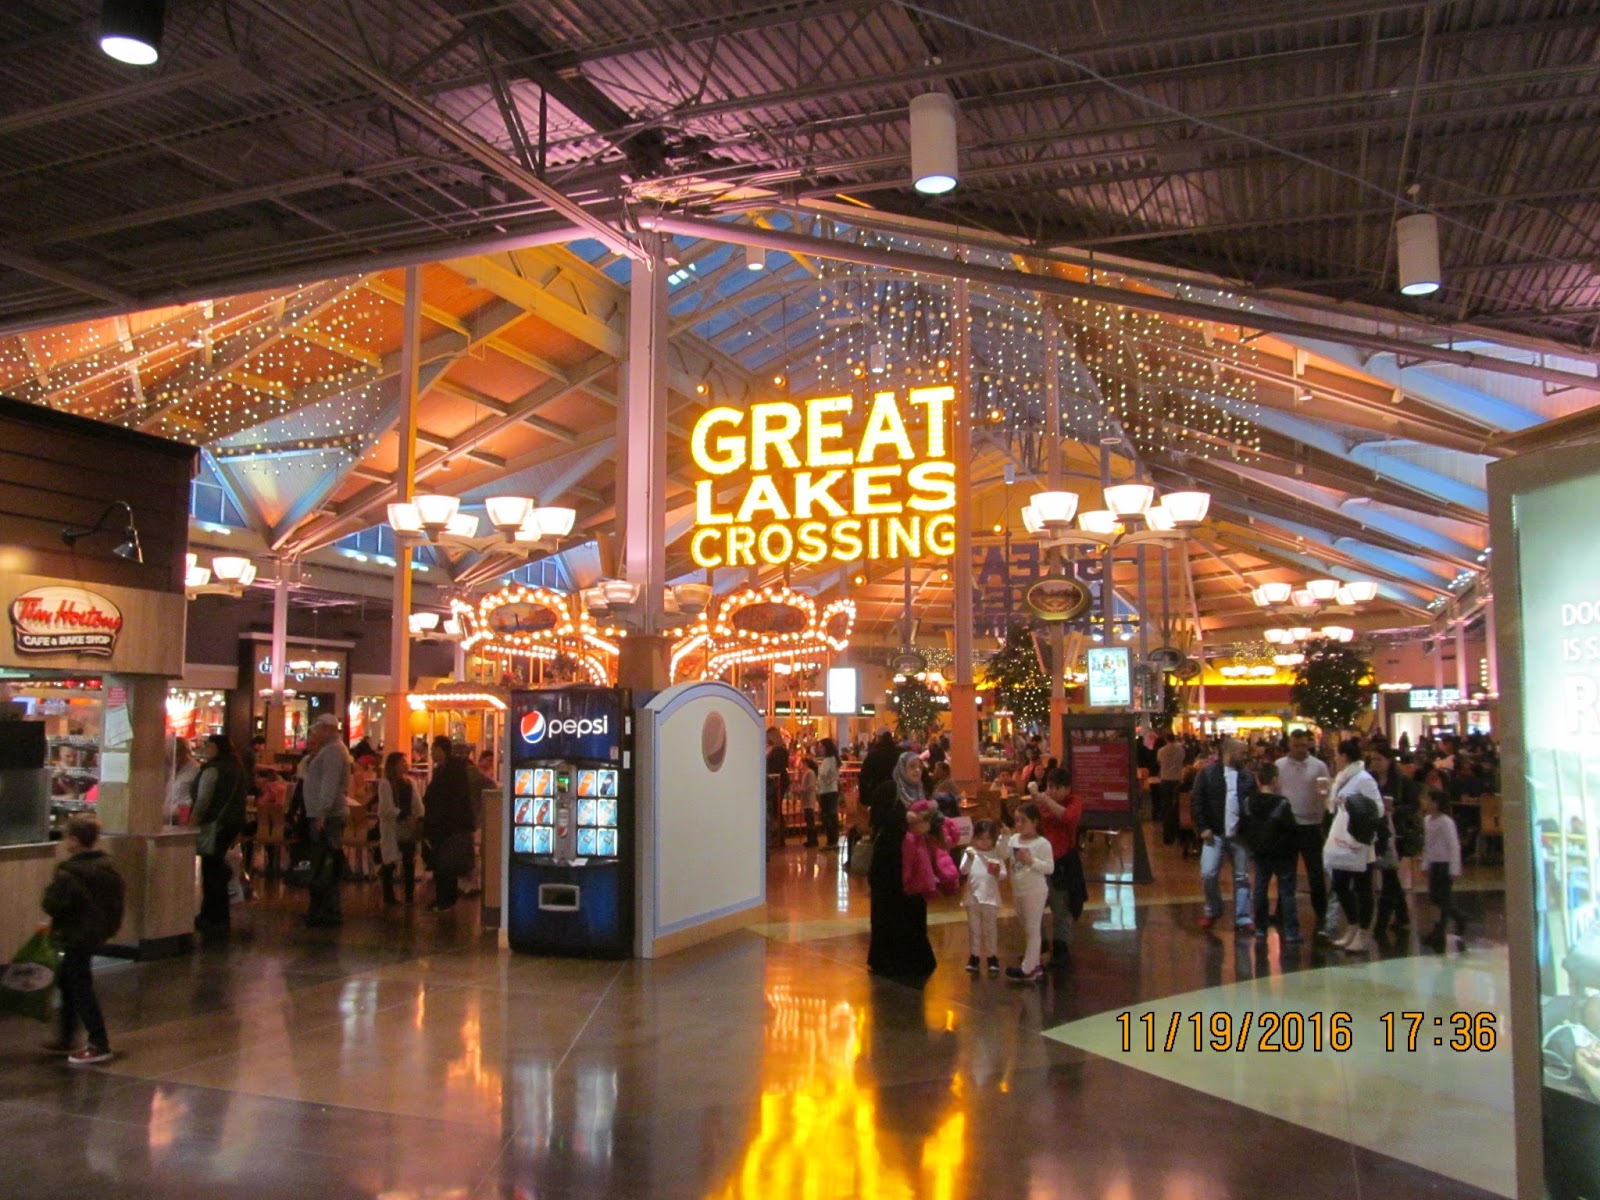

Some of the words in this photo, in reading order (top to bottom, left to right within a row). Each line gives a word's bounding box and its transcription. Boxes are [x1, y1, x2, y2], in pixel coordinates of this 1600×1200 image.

[691, 386, 955, 474] GREAT
[691, 461, 956, 526] LAKES
[691, 514, 956, 567] CROSSING
[18, 597, 52, 624] Tim
[55, 600, 122, 629] Hortons
[23, 636, 50, 647] CAFE
[59, 636, 84, 645] BAKE
[86, 635, 110, 644] SHOP
[1563, 638, 1582, 661] IS
[548, 715, 608, 738] pepsi
